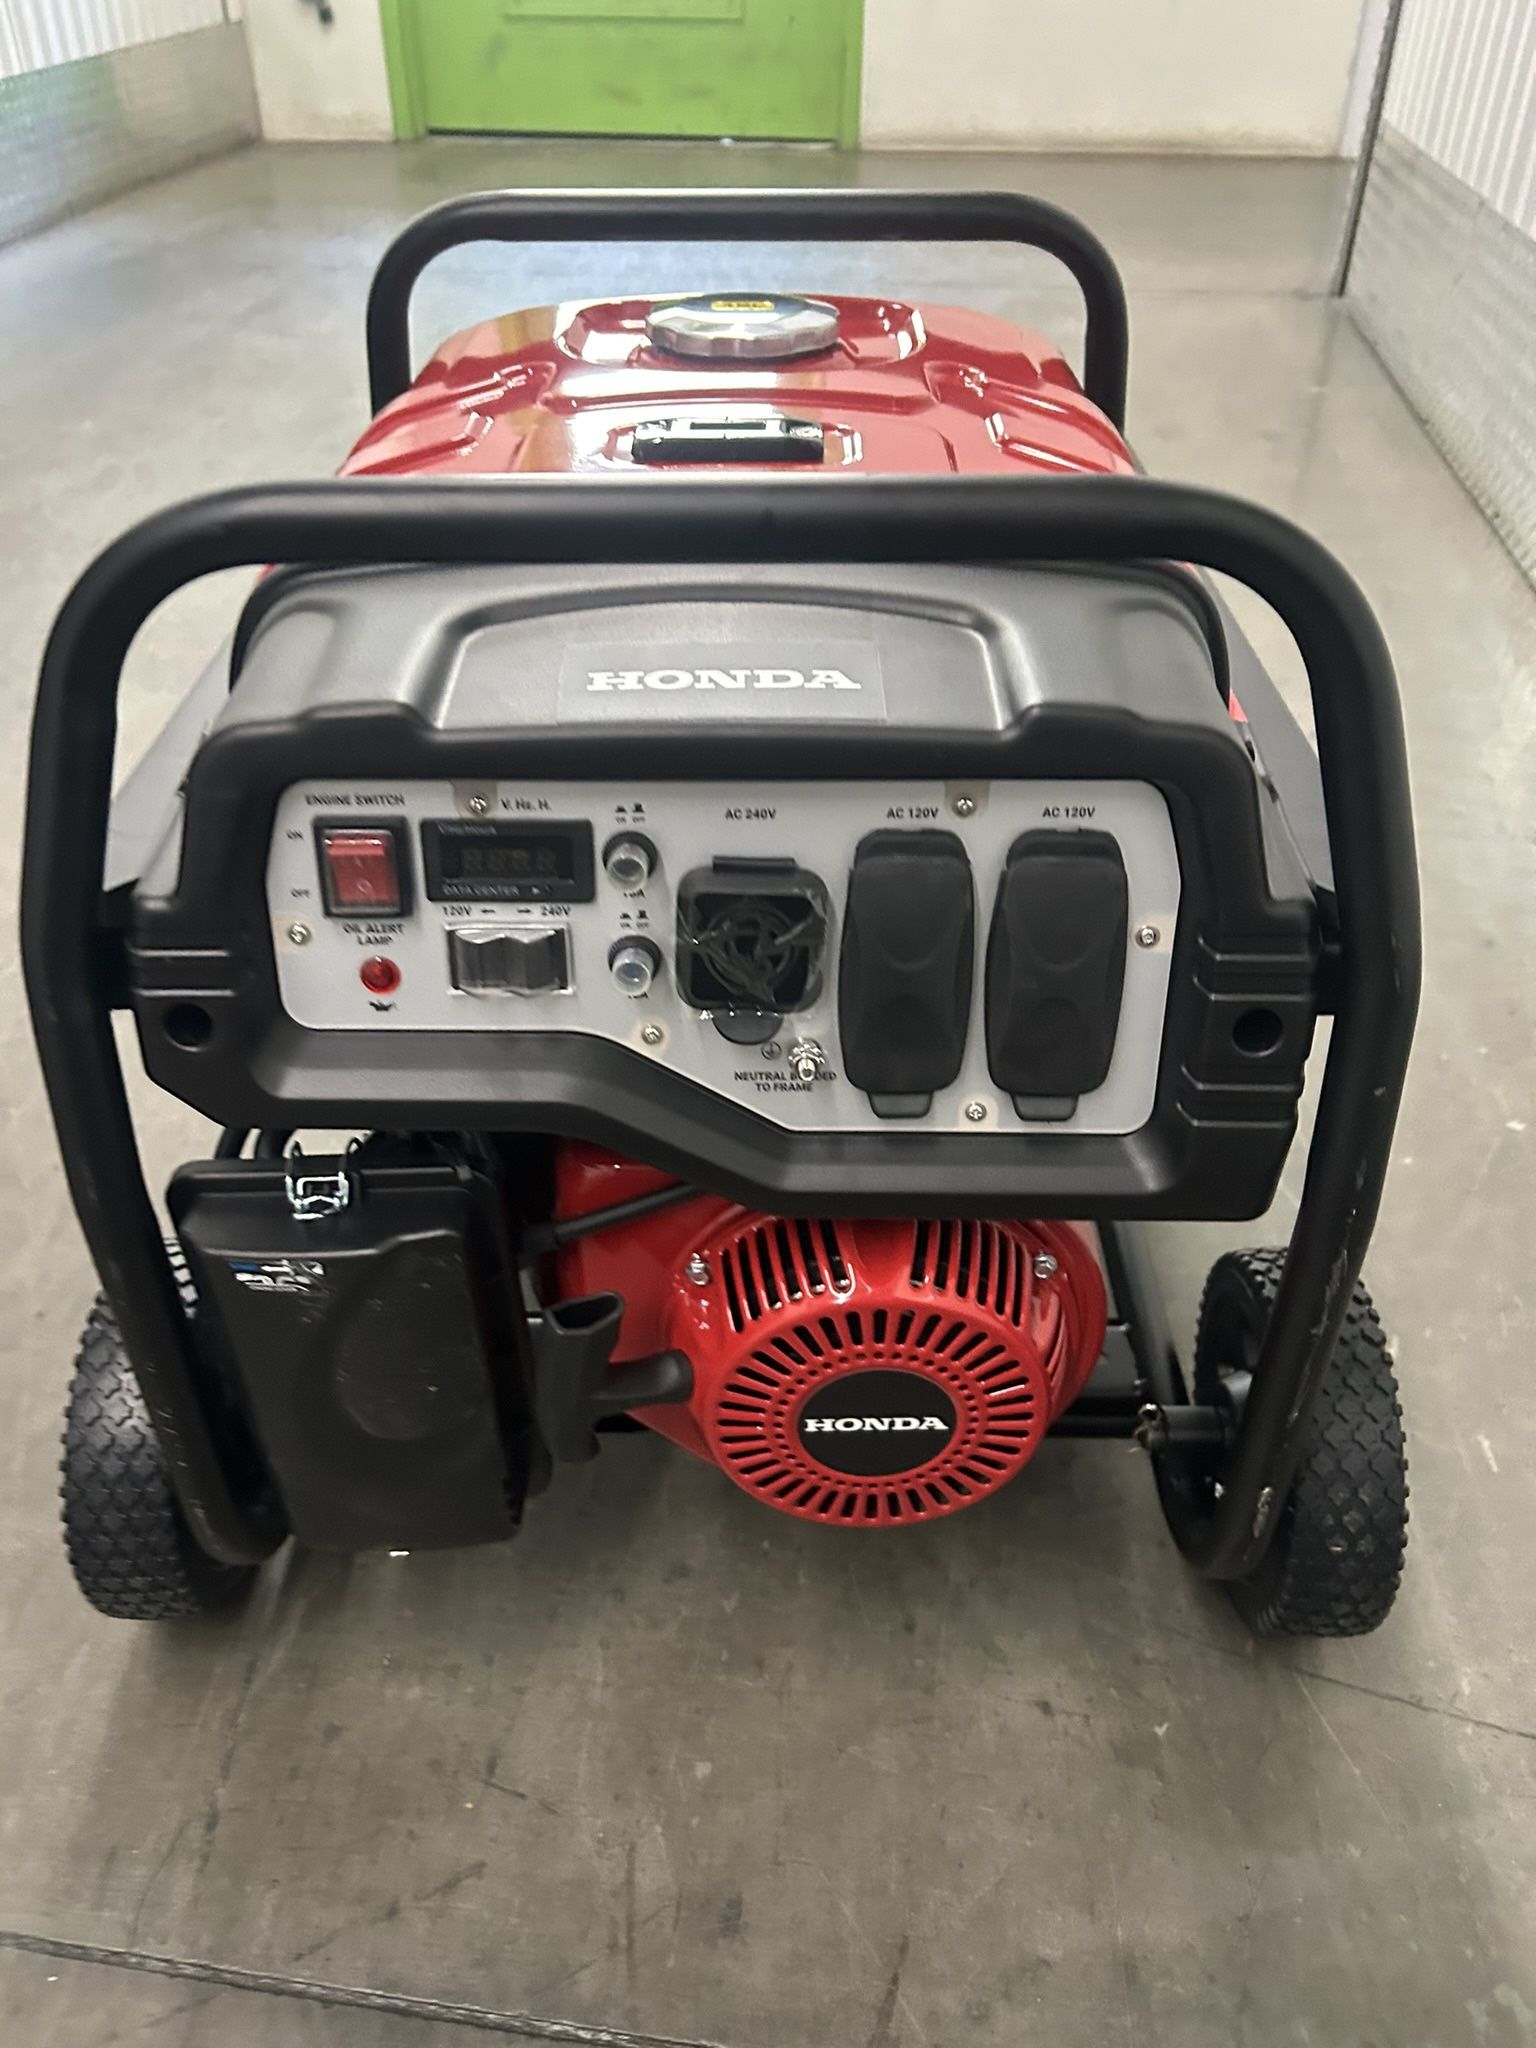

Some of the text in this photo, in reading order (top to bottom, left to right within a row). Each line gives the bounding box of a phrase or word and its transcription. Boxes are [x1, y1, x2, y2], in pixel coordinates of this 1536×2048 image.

[586, 668, 863, 691] HONDA
[304, 794, 405, 806] ENGINE SWITCH
[725, 808, 777, 820] AC 240V
[886, 807, 939, 819] AC 120V
[1042, 806, 1096, 818] AC 120V
[287, 829, 304, 841] ON
[442, 905, 571, 917] 120V 240V
[343, 922, 404, 935] OIL ALERT
[357, 934, 394, 946] LAMP
[734, 1071, 787, 1081] NEUTRAL
[755, 1082, 813, 1093] TO FRAME
[804, 1416, 949, 1432] HONDA
